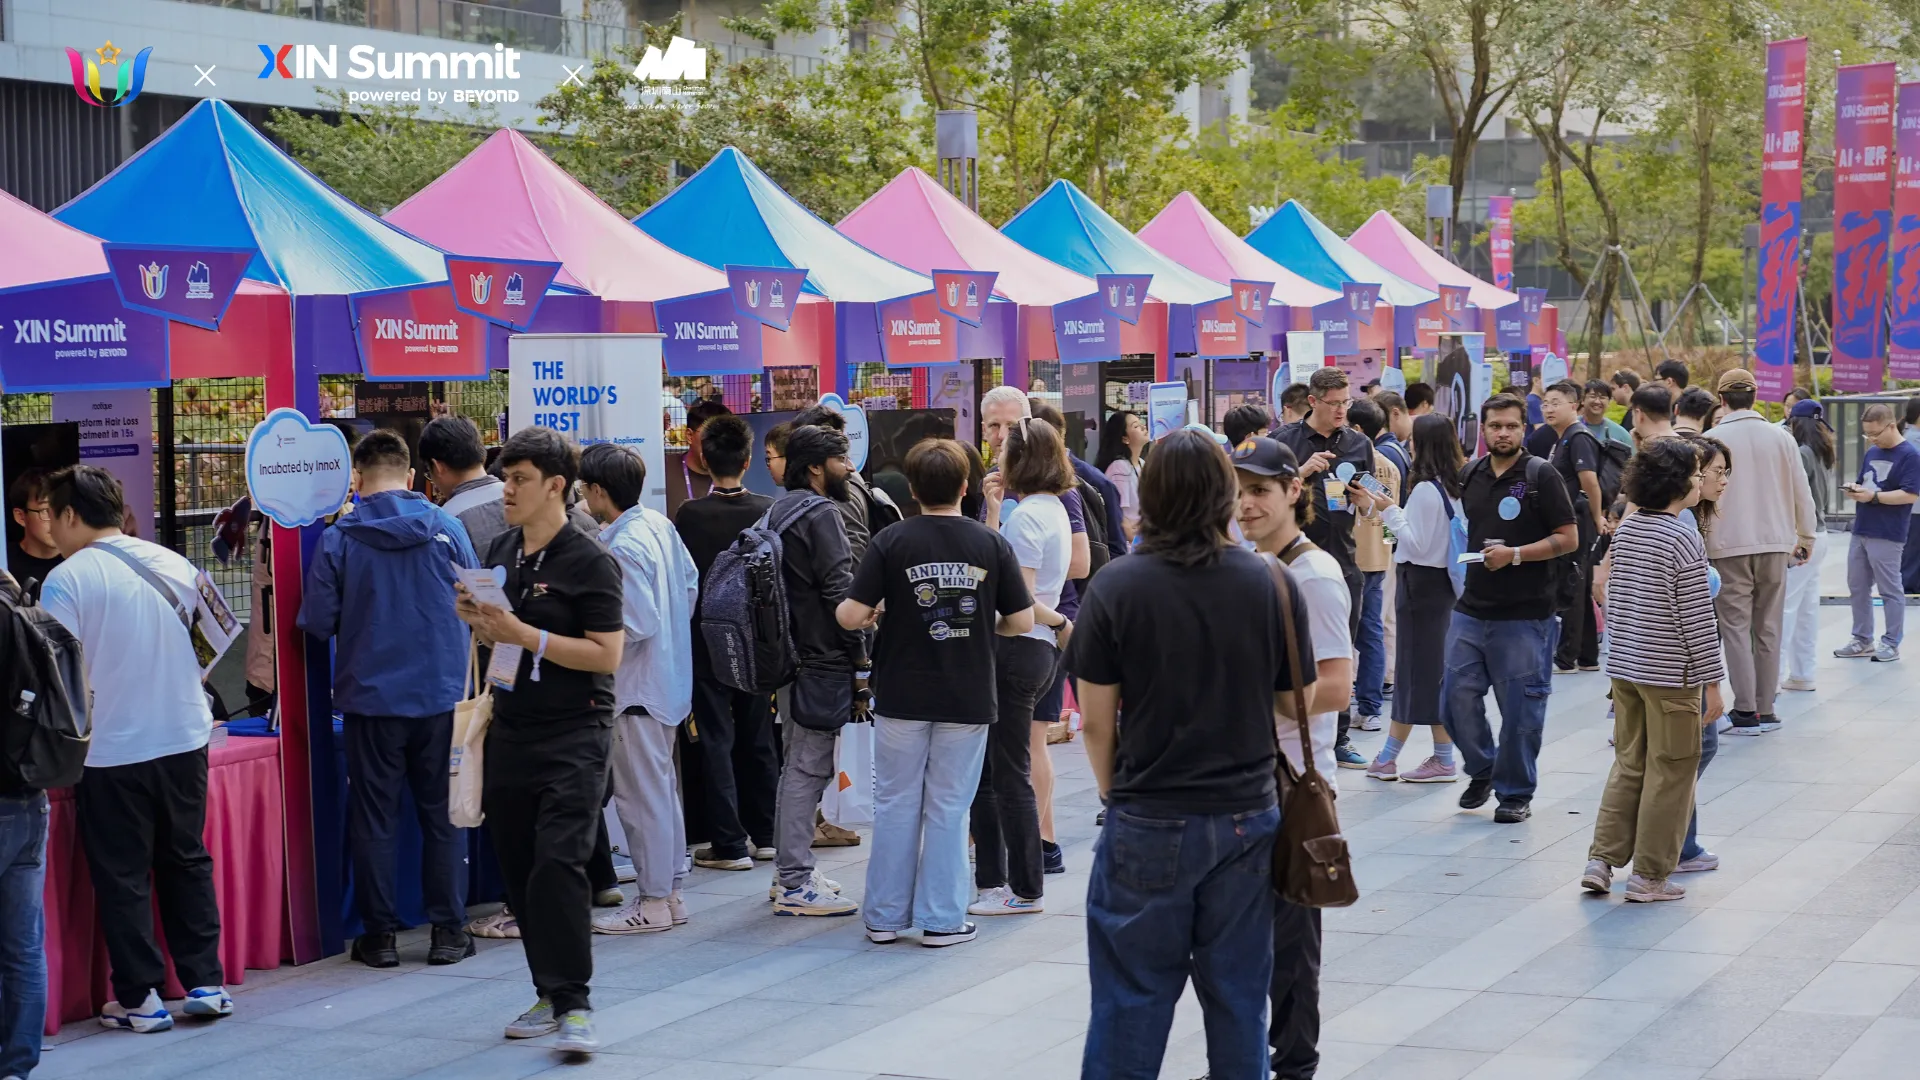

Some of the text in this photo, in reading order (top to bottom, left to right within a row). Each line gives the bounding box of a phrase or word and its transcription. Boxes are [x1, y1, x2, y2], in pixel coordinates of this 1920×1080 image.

[1764, 133, 1775, 153] AI
[1839, 148, 1853, 168] AI
[14, 317, 127, 343] XIN Summit
[375, 318, 459, 340] XIN Summit
[674, 320, 739, 340] XIN Summit
[891, 318, 941, 335] XIN Summit
[1064, 318, 1105, 335] XIN Summit
[1213, 319, 1236, 333] Summit
[55, 348, 87, 359] powered
[89, 348, 97, 359] by
[405, 345, 428, 354] powered
[532, 361, 564, 380] THE
[532, 385, 617, 406] WORLD'S
[105, 417, 120, 426] Hair
[123, 416, 139, 426] Loss
[534, 412, 581, 432] FIRST
[111, 430, 119, 439] in
[121, 428, 134, 438] 15s
[614, 437, 645, 445] Applicator
[259, 458, 341, 476] Incubated by InnoX
[910, 563, 966, 580] ANDIYX
[942, 578, 974, 587] MIND
[725, 632, 737, 656] Fox
